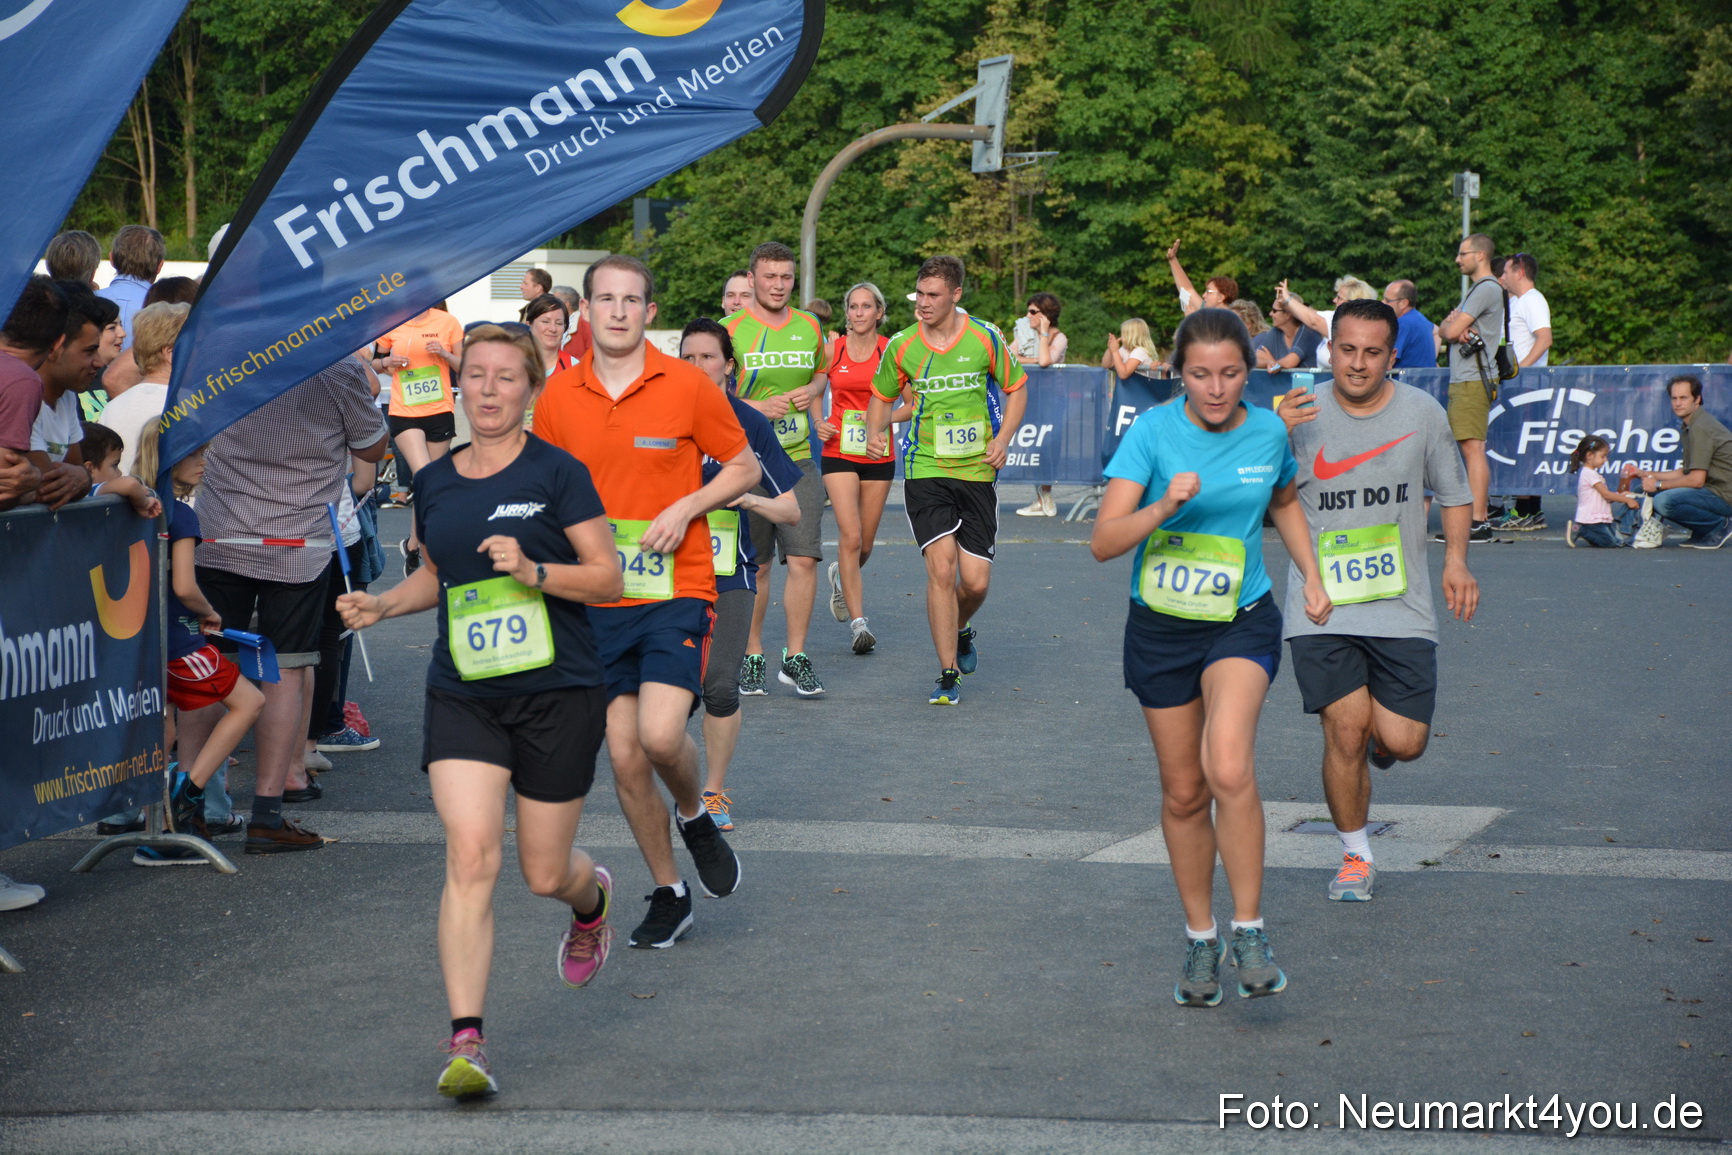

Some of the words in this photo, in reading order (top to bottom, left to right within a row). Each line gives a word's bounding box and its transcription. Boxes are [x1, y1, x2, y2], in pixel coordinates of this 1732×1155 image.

[524, 114, 616, 177] Druck
[618, 86, 677, 126] und
[676, 24, 785, 100] Medien
[273, 46, 656, 269] Frischmann
[158, 270, 408, 434] www.frischmann-net.de
[743, 350, 815, 371] BOCK
[405, 379, 439, 397] 1562
[945, 426, 977, 445] 136
[1517, 419, 1684, 455] Fische
[488, 503, 530, 521] JURA
[1318, 489, 1357, 511] JUST
[1363, 486, 1390, 507] DO
[1153, 561, 1231, 597] 1079
[1329, 552, 1396, 584] 1658
[467, 614, 528, 652] 679
[33, 699, 70, 745] Druck
[73, 691, 107, 734] und
[108, 681, 160, 725] Medien
[33, 743, 164, 804] www.frischmann-net.de
